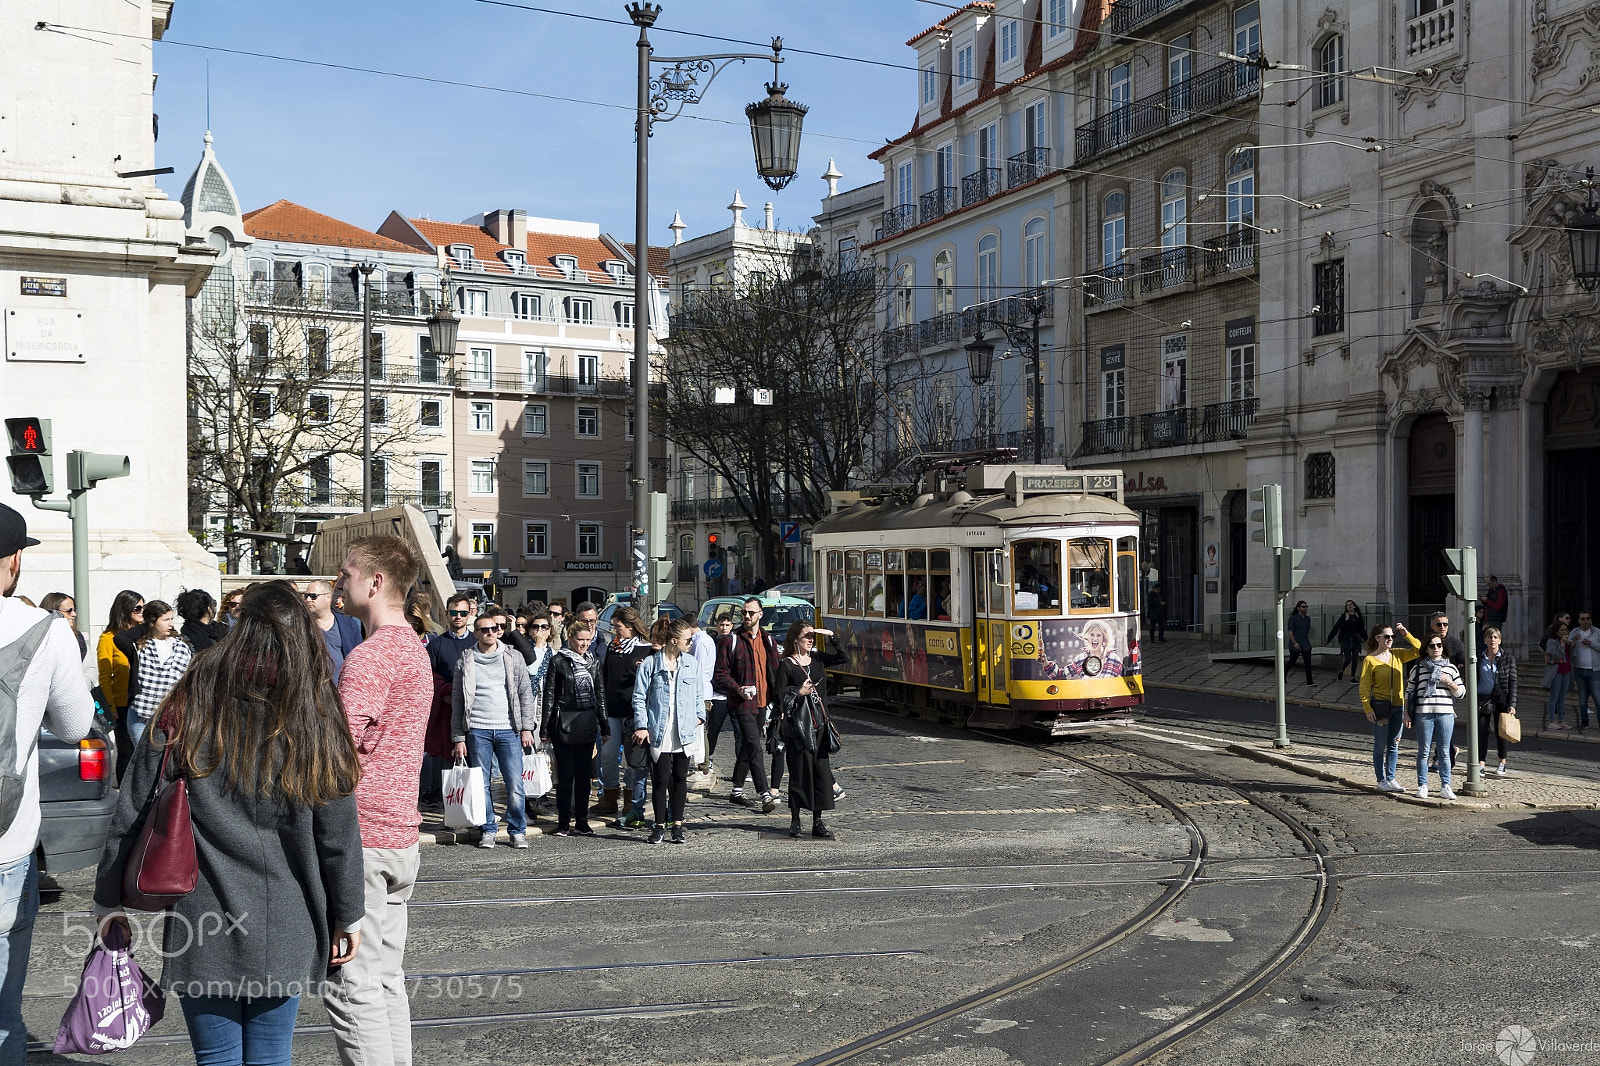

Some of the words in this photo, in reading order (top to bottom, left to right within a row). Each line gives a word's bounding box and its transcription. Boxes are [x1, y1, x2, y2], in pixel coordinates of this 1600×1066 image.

[37, 316, 56, 326] RUA
[40, 329, 54, 338] DA
[15, 341, 79, 351] MISERICORDIA
[1027, 478, 1080, 489] PRAZERES
[1093, 476, 1112, 488] 28
[566, 562, 613, 570] McDonald's
[928, 637, 945, 648] carris
